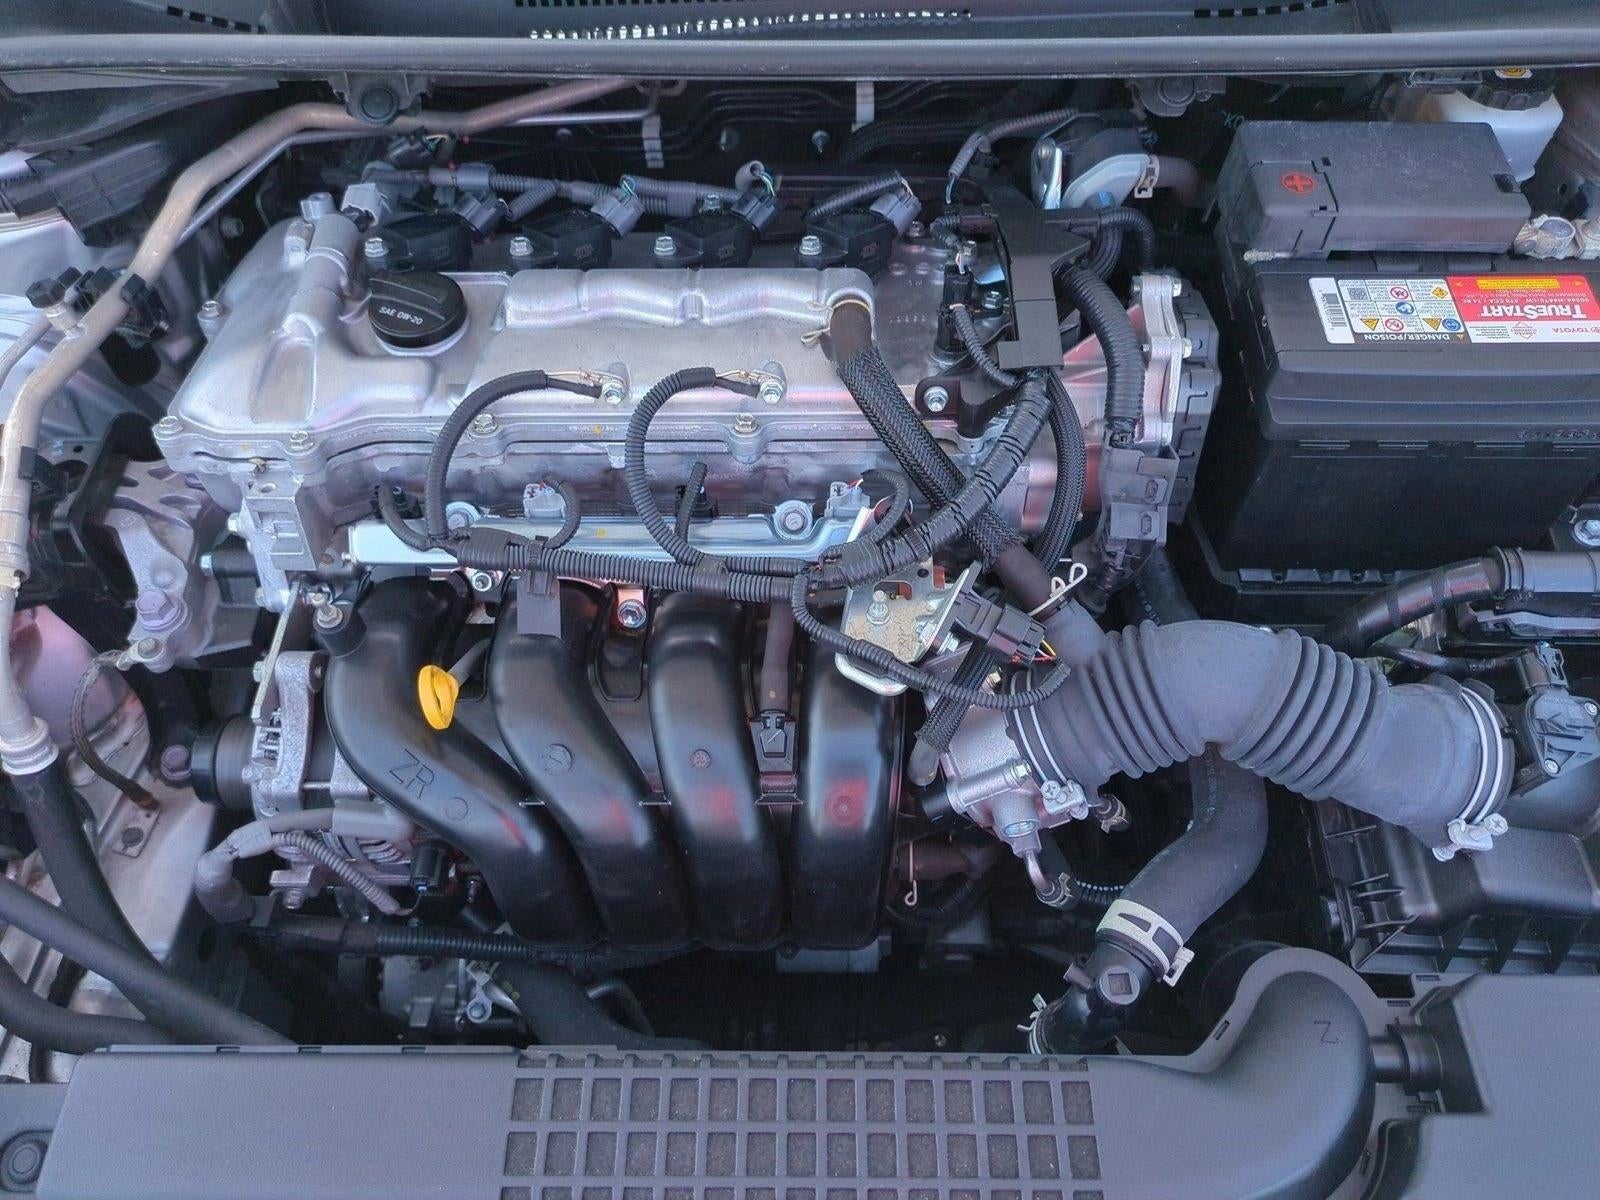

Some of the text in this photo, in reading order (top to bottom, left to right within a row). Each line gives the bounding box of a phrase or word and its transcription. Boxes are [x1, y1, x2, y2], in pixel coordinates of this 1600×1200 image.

[379, 306, 396, 316] SAE
[1363, 333, 1451, 341] DANGER/POISON
[388, 748, 435, 800] ZR
